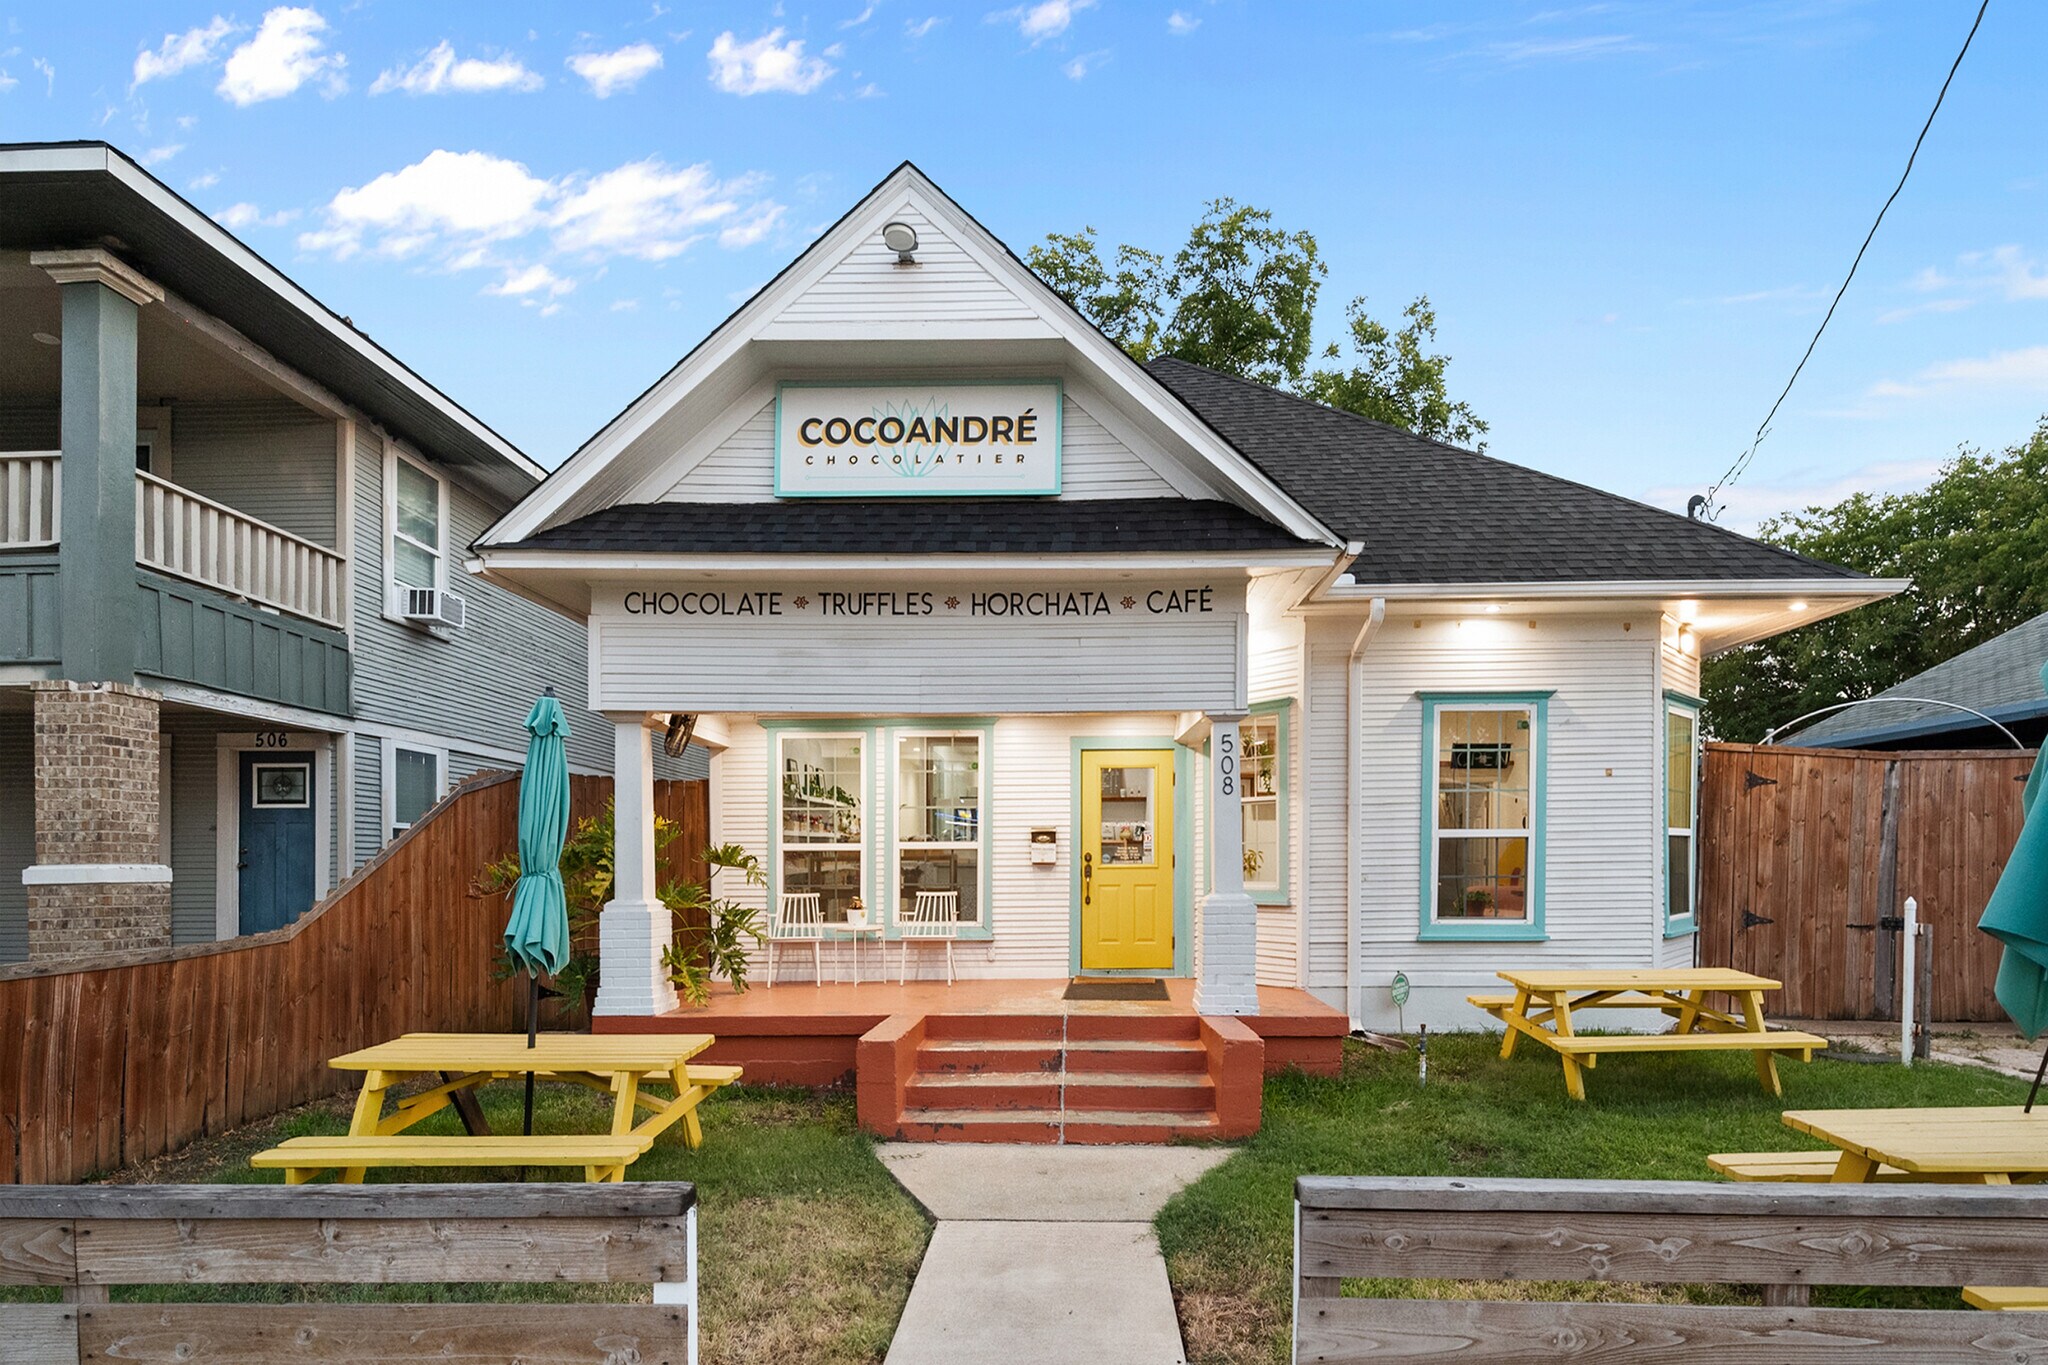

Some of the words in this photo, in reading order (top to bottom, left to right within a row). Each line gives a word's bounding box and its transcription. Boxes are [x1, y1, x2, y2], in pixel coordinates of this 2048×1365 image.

[799, 408, 1038, 446] COCOANDRÉ
[805, 453, 1026, 466] CHOCOLATIER
[624, 591, 783, 616] CHOCOLATE
[818, 592, 934, 616] TRUFFLES
[971, 592, 1111, 616] HORCHATA
[1146, 585, 1214, 614] CAFÉ
[255, 732, 288, 748] 506
[1220, 733, 1234, 796] 508
[1456, 751, 1509, 767] OPEN
